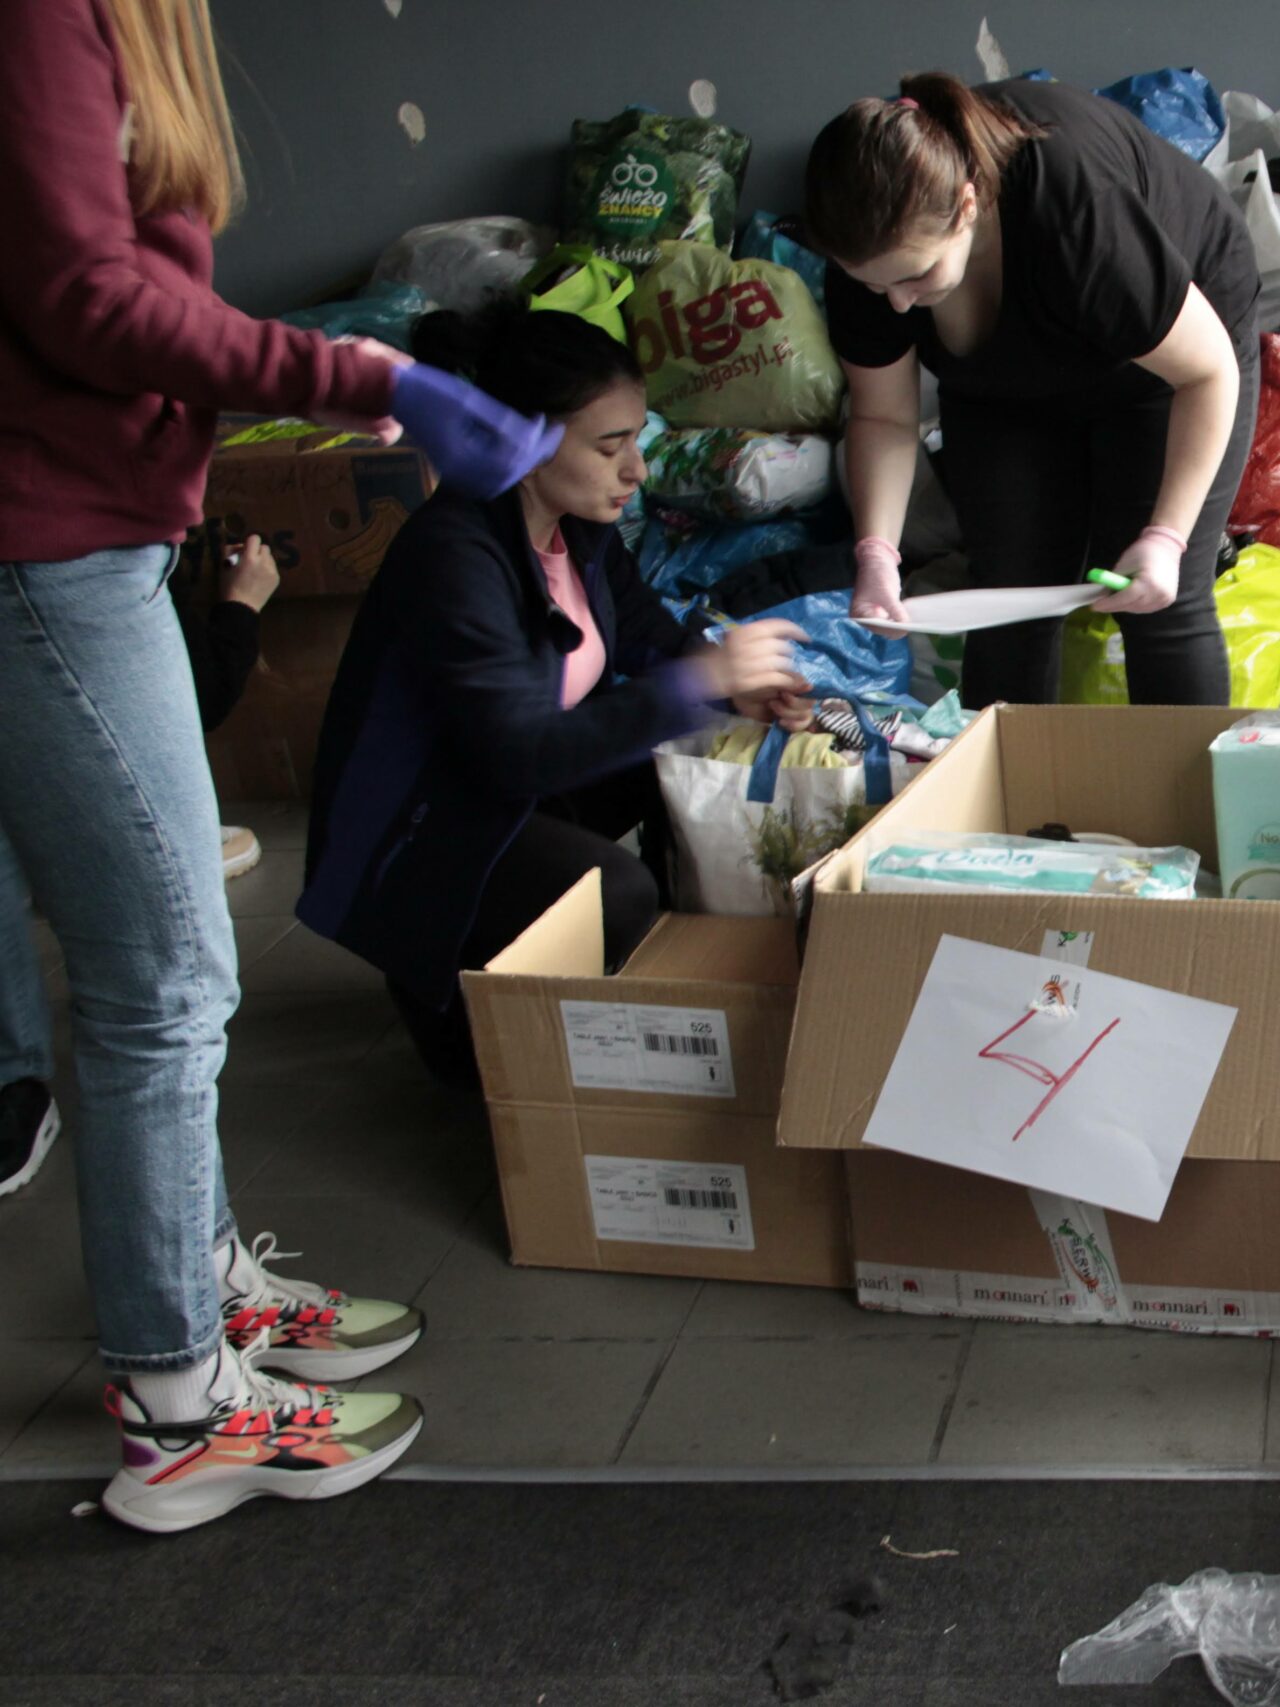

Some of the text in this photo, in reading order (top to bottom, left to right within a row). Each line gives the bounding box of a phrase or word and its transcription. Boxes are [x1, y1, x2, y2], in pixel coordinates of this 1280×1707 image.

[630, 279, 784, 374] biga
[690, 1021, 713, 1034] 525
[978, 1008, 1122, 1142] 4
[710, 1176, 732, 1188] 525
